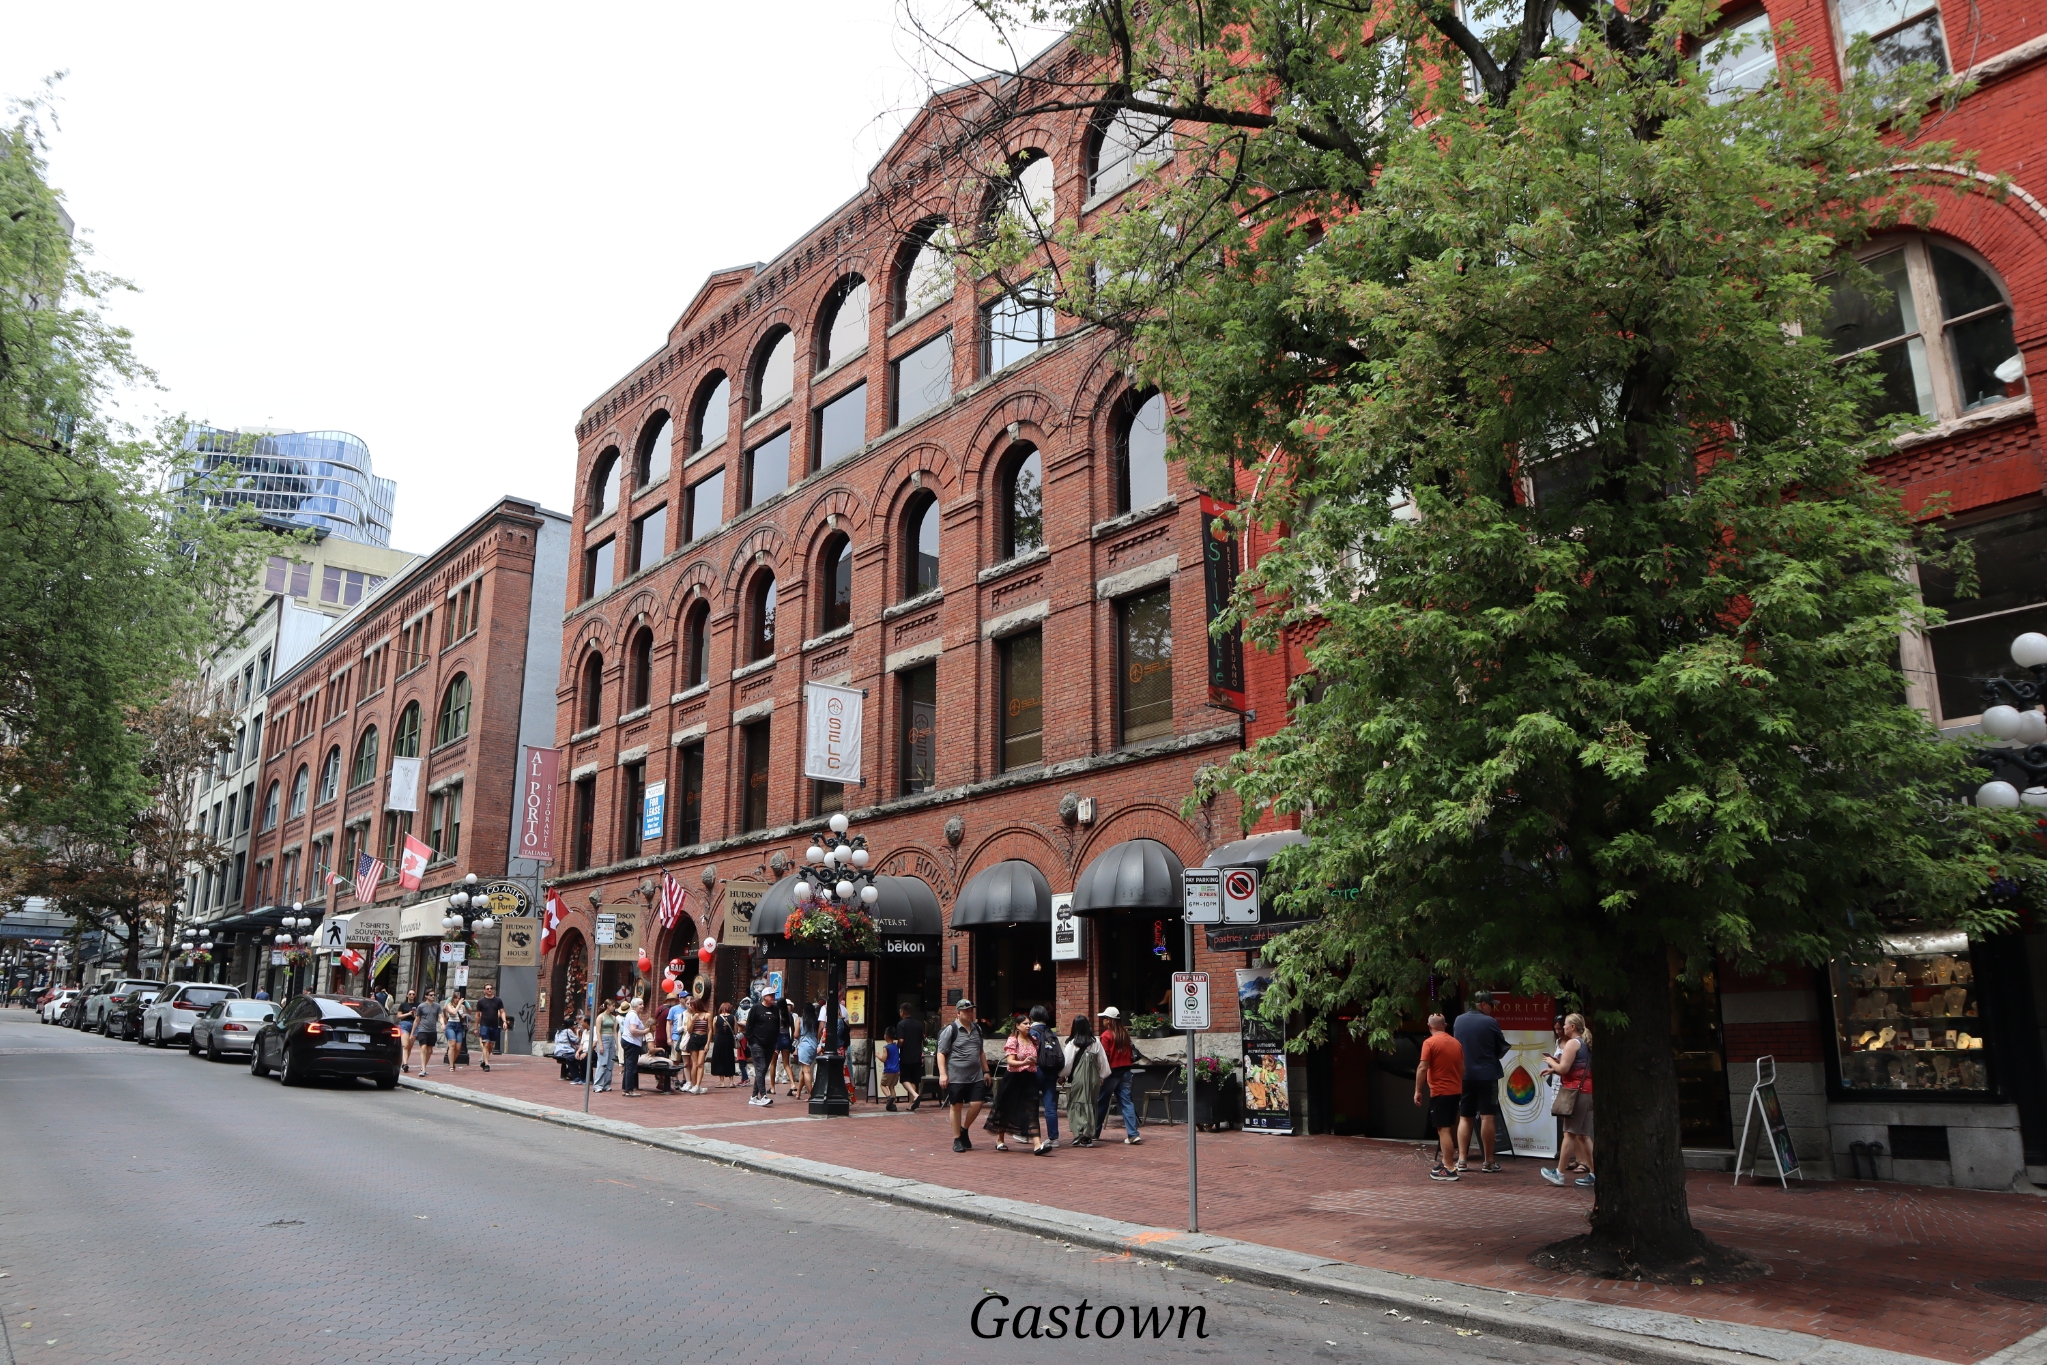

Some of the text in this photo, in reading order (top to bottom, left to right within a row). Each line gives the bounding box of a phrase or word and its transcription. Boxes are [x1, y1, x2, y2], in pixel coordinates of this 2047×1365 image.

[1230, 634, 1238, 687] PERUANO
[828, 717, 841, 769] SELC
[524, 751, 543, 846] AL PORTO
[649, 797, 659, 807] FOR
[543, 784, 552, 848] RISTORANTE
[646, 805, 661, 817] LEASE
[501, 886, 525, 906] ANTICO
[497, 902, 515, 910] Porto
[732, 925, 750, 933] HOU
[1213, 933, 1242, 948] pastries
[1251, 929, 1266, 941] café
[670, 963, 686, 972] SALE
[1493, 1003, 1549, 1012] KORITE
